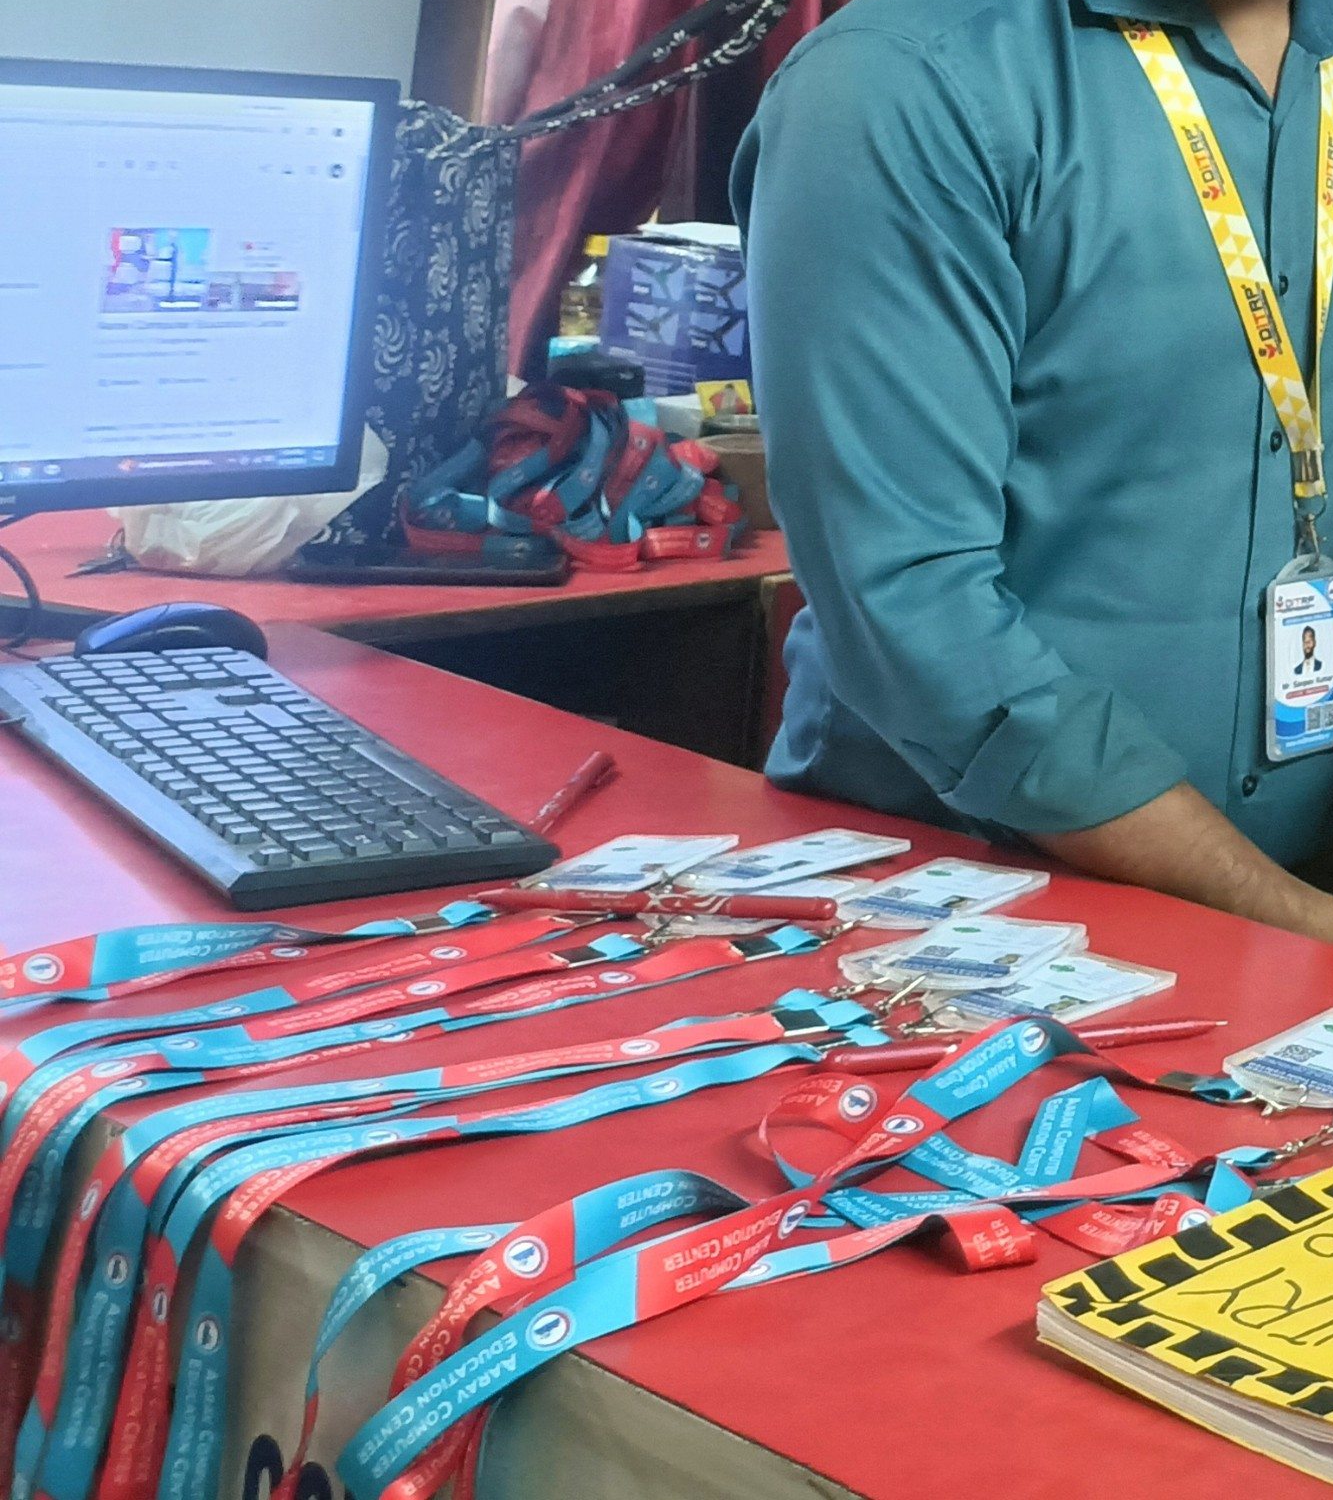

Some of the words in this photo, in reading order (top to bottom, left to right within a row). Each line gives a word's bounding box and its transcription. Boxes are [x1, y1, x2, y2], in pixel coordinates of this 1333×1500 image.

[618, 1181, 673, 1208] CENTER
[663, 1239, 719, 1271] CENTER
[674, 1253, 741, 1293] COMPUTER
[448, 1275, 501, 1326] AARAV
[416, 1331, 518, 1408] EDUCATION
[457, 1353, 517, 1403] AARAV
[357, 1406, 415, 1465] CENTER
[371, 1401, 453, 1479] COMPUTER
